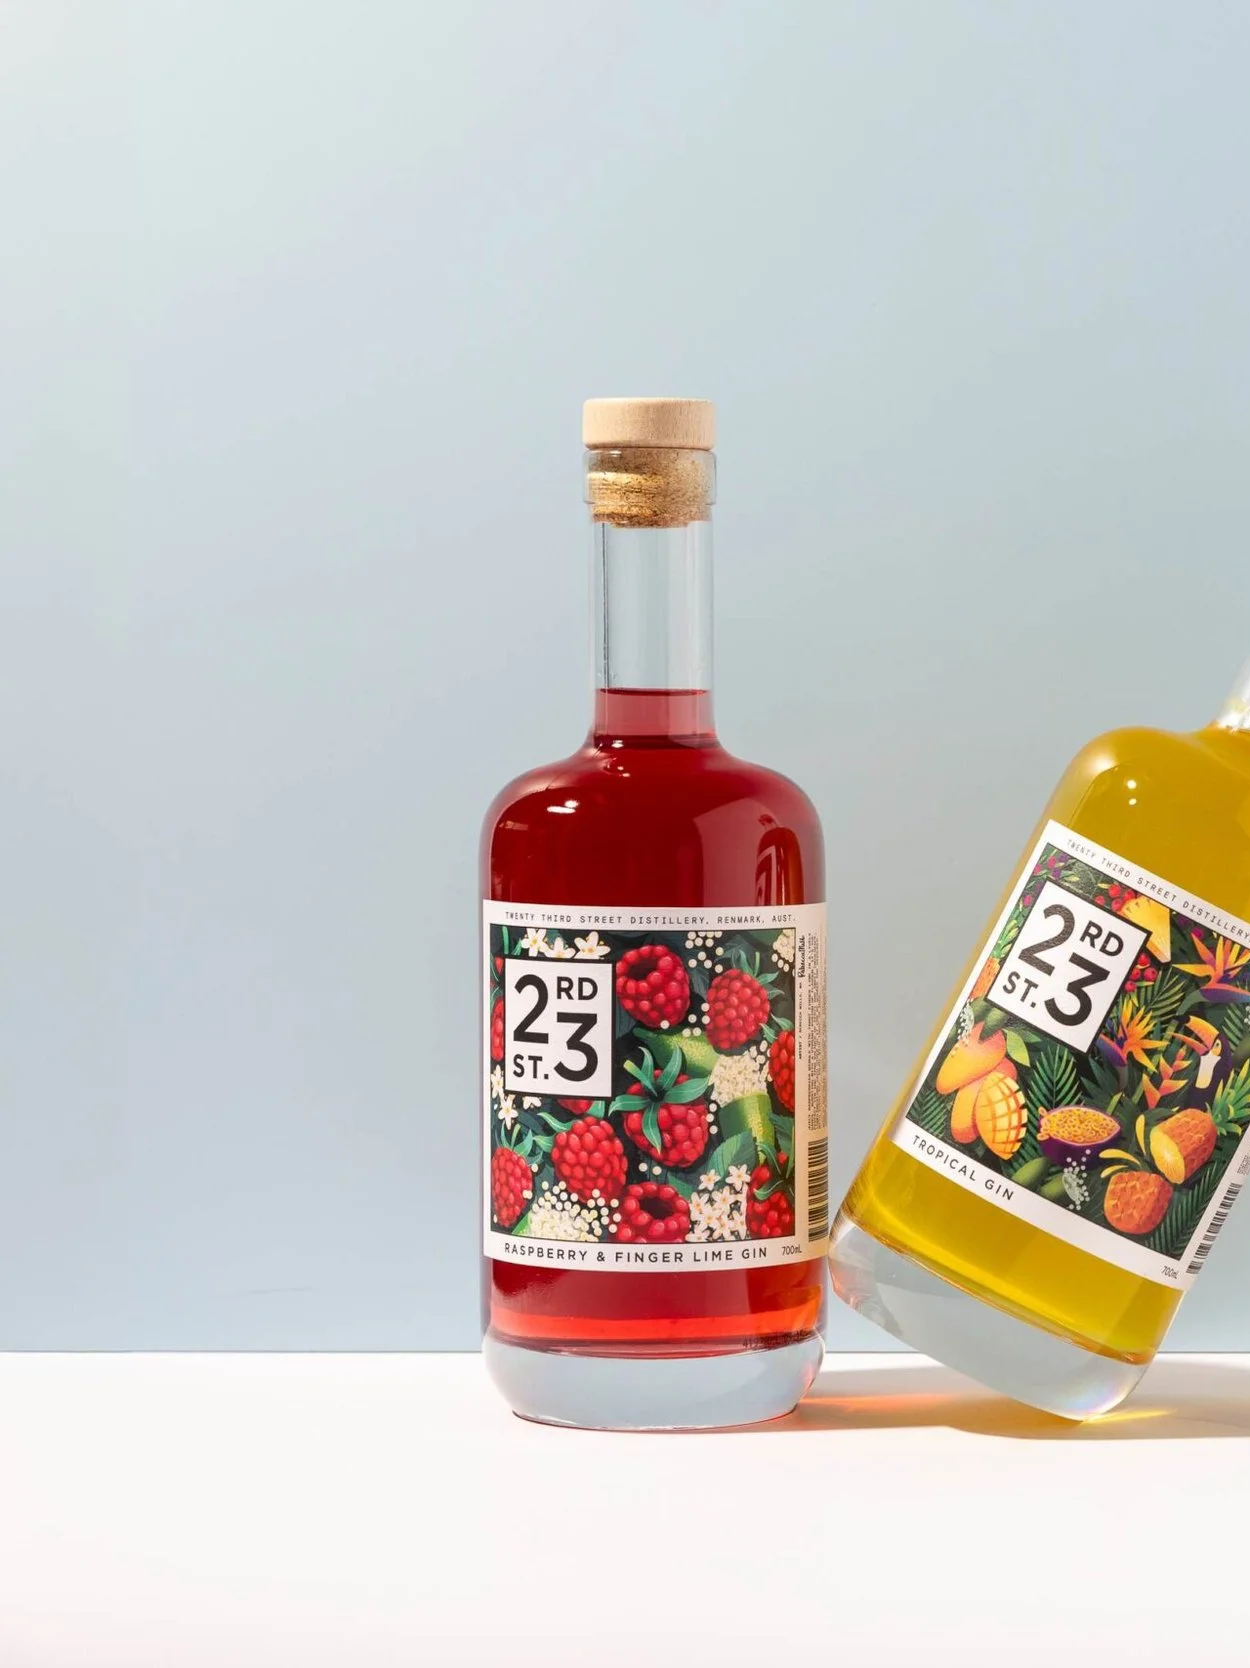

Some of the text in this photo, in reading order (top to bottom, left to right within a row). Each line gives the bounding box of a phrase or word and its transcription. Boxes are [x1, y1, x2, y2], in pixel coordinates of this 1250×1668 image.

[1101, 858, 1131, 878] THIRD
[1137, 877, 1178, 902] STREET
[505, 911, 796, 925] TWENTY THIRD STREET DISTILLERY, RENMARK, AUST.
[1018, 903, 1124, 977] 2 RD
[513, 973, 599, 1045] 2 RD
[1002, 952, 1111, 1026] ST. 3
[512, 1011, 599, 1083] ST. 3
[912, 1134, 1014, 1201] TROPICAL GIN
[504, 1242, 767, 1263] RASPBERRY & FINGER LIME GIN
